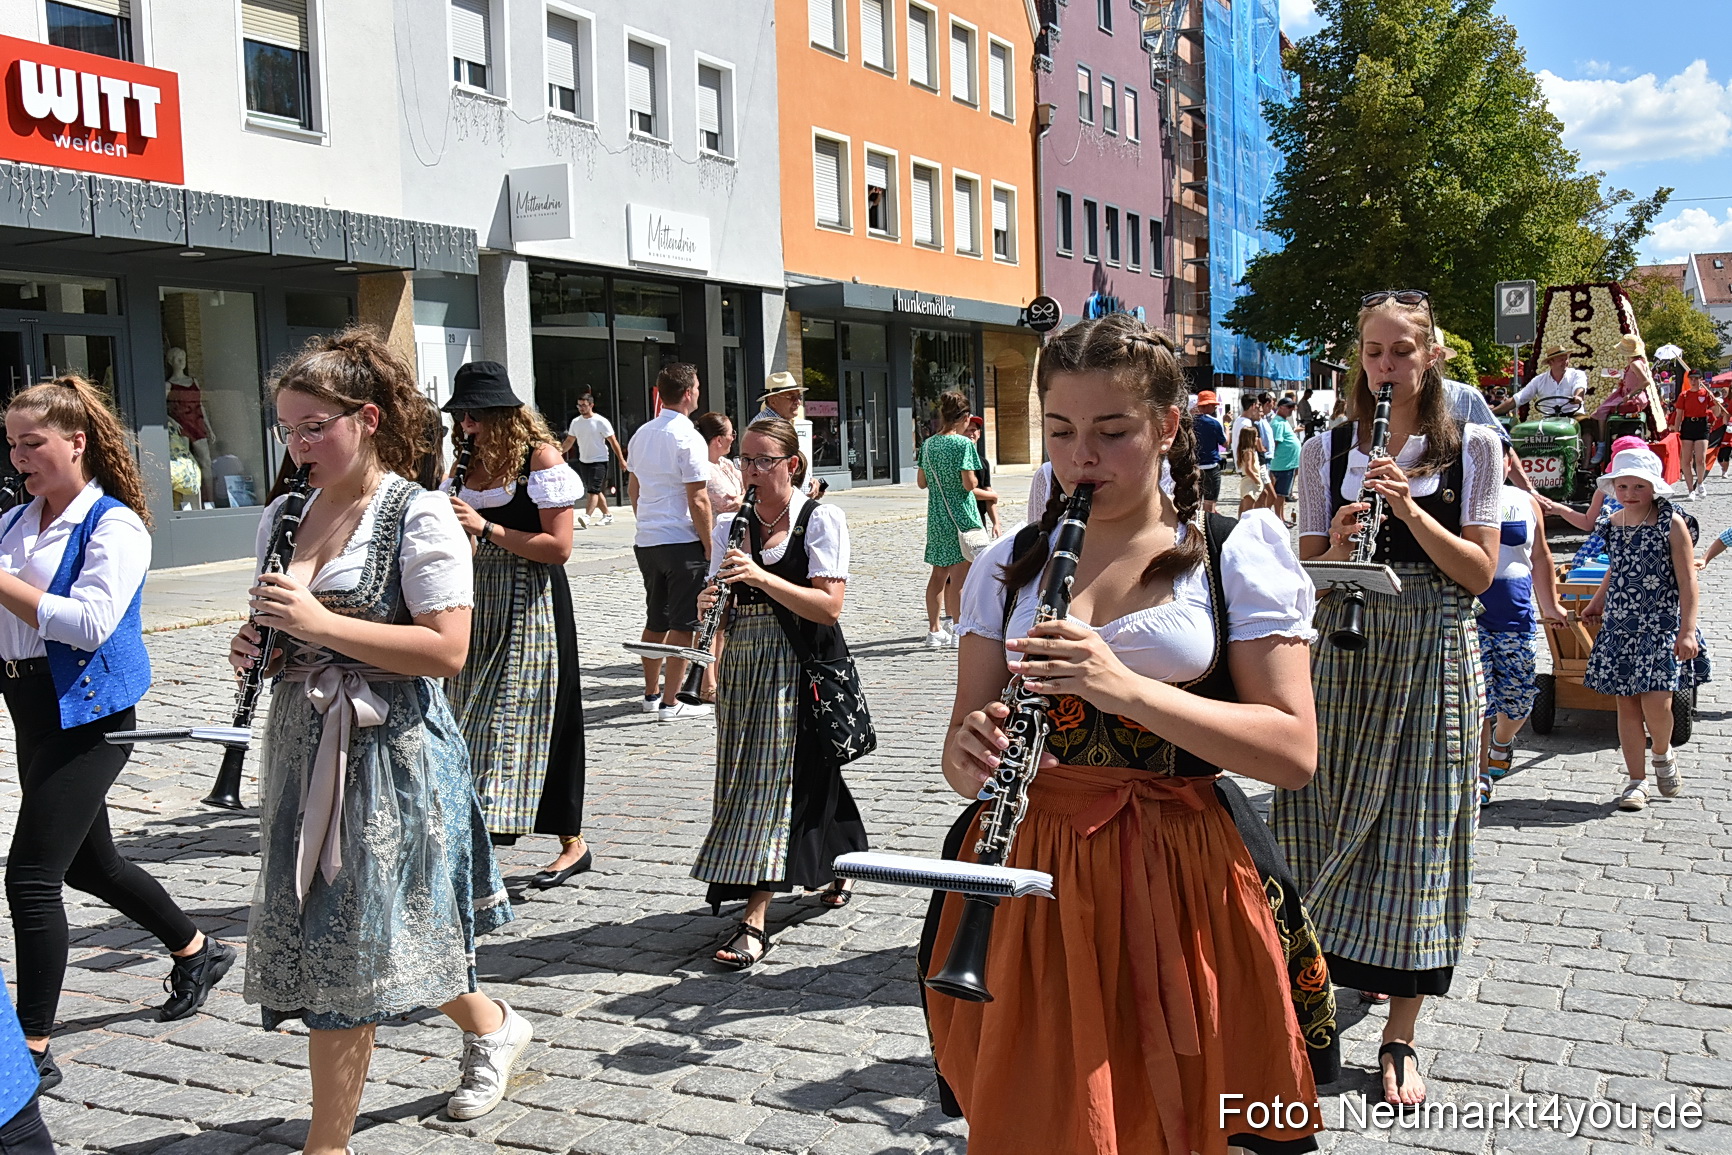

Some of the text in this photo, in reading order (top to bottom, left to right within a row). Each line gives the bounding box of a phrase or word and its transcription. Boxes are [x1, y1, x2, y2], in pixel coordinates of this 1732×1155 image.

[19, 59, 161, 139] WITT
[52, 133, 128, 158] weiden
[516, 191, 562, 214] Mittendrin
[647, 213, 696, 253] Mittendrin
[897, 289, 955, 317] hunkemöller
[1524, 435, 1556, 443] FENDT
[1521, 457, 1557, 473] BSC
